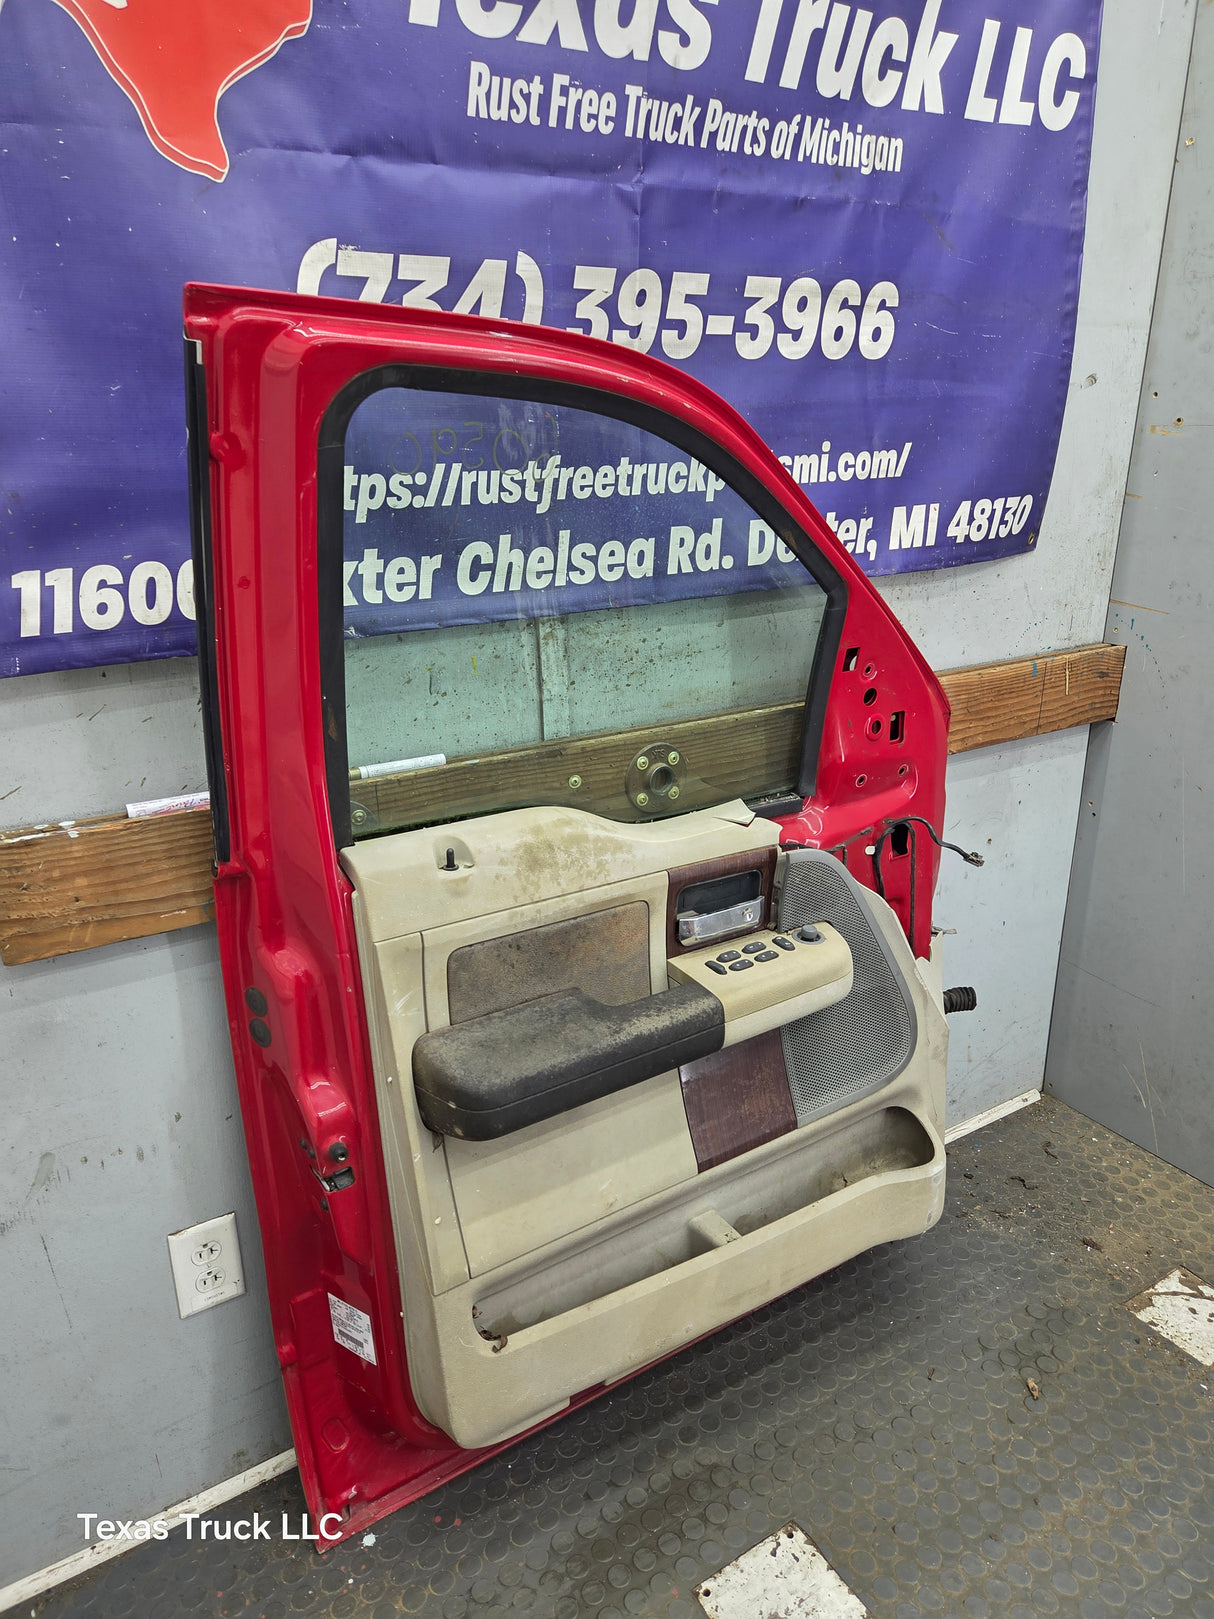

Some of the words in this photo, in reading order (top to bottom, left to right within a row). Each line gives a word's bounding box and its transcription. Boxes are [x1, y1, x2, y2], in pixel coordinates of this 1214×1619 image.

[408, 0, 712, 70] exas
[964, 18, 1086, 131] LLC
[467, 60, 543, 126] Rust
[548, 72, 616, 135] Free
[623, 84, 701, 148] Truck
[700, 98, 768, 157] Parts
[770, 113, 801, 161] of
[800, 121, 904, 173] Michigan
[567, 266, 899, 361] 395-3966
[456, 528, 655, 596] Chelsea
[667, 518, 735, 576] Rd.
[888, 503, 938, 551] MI
[946, 494, 1034, 543] 48130
